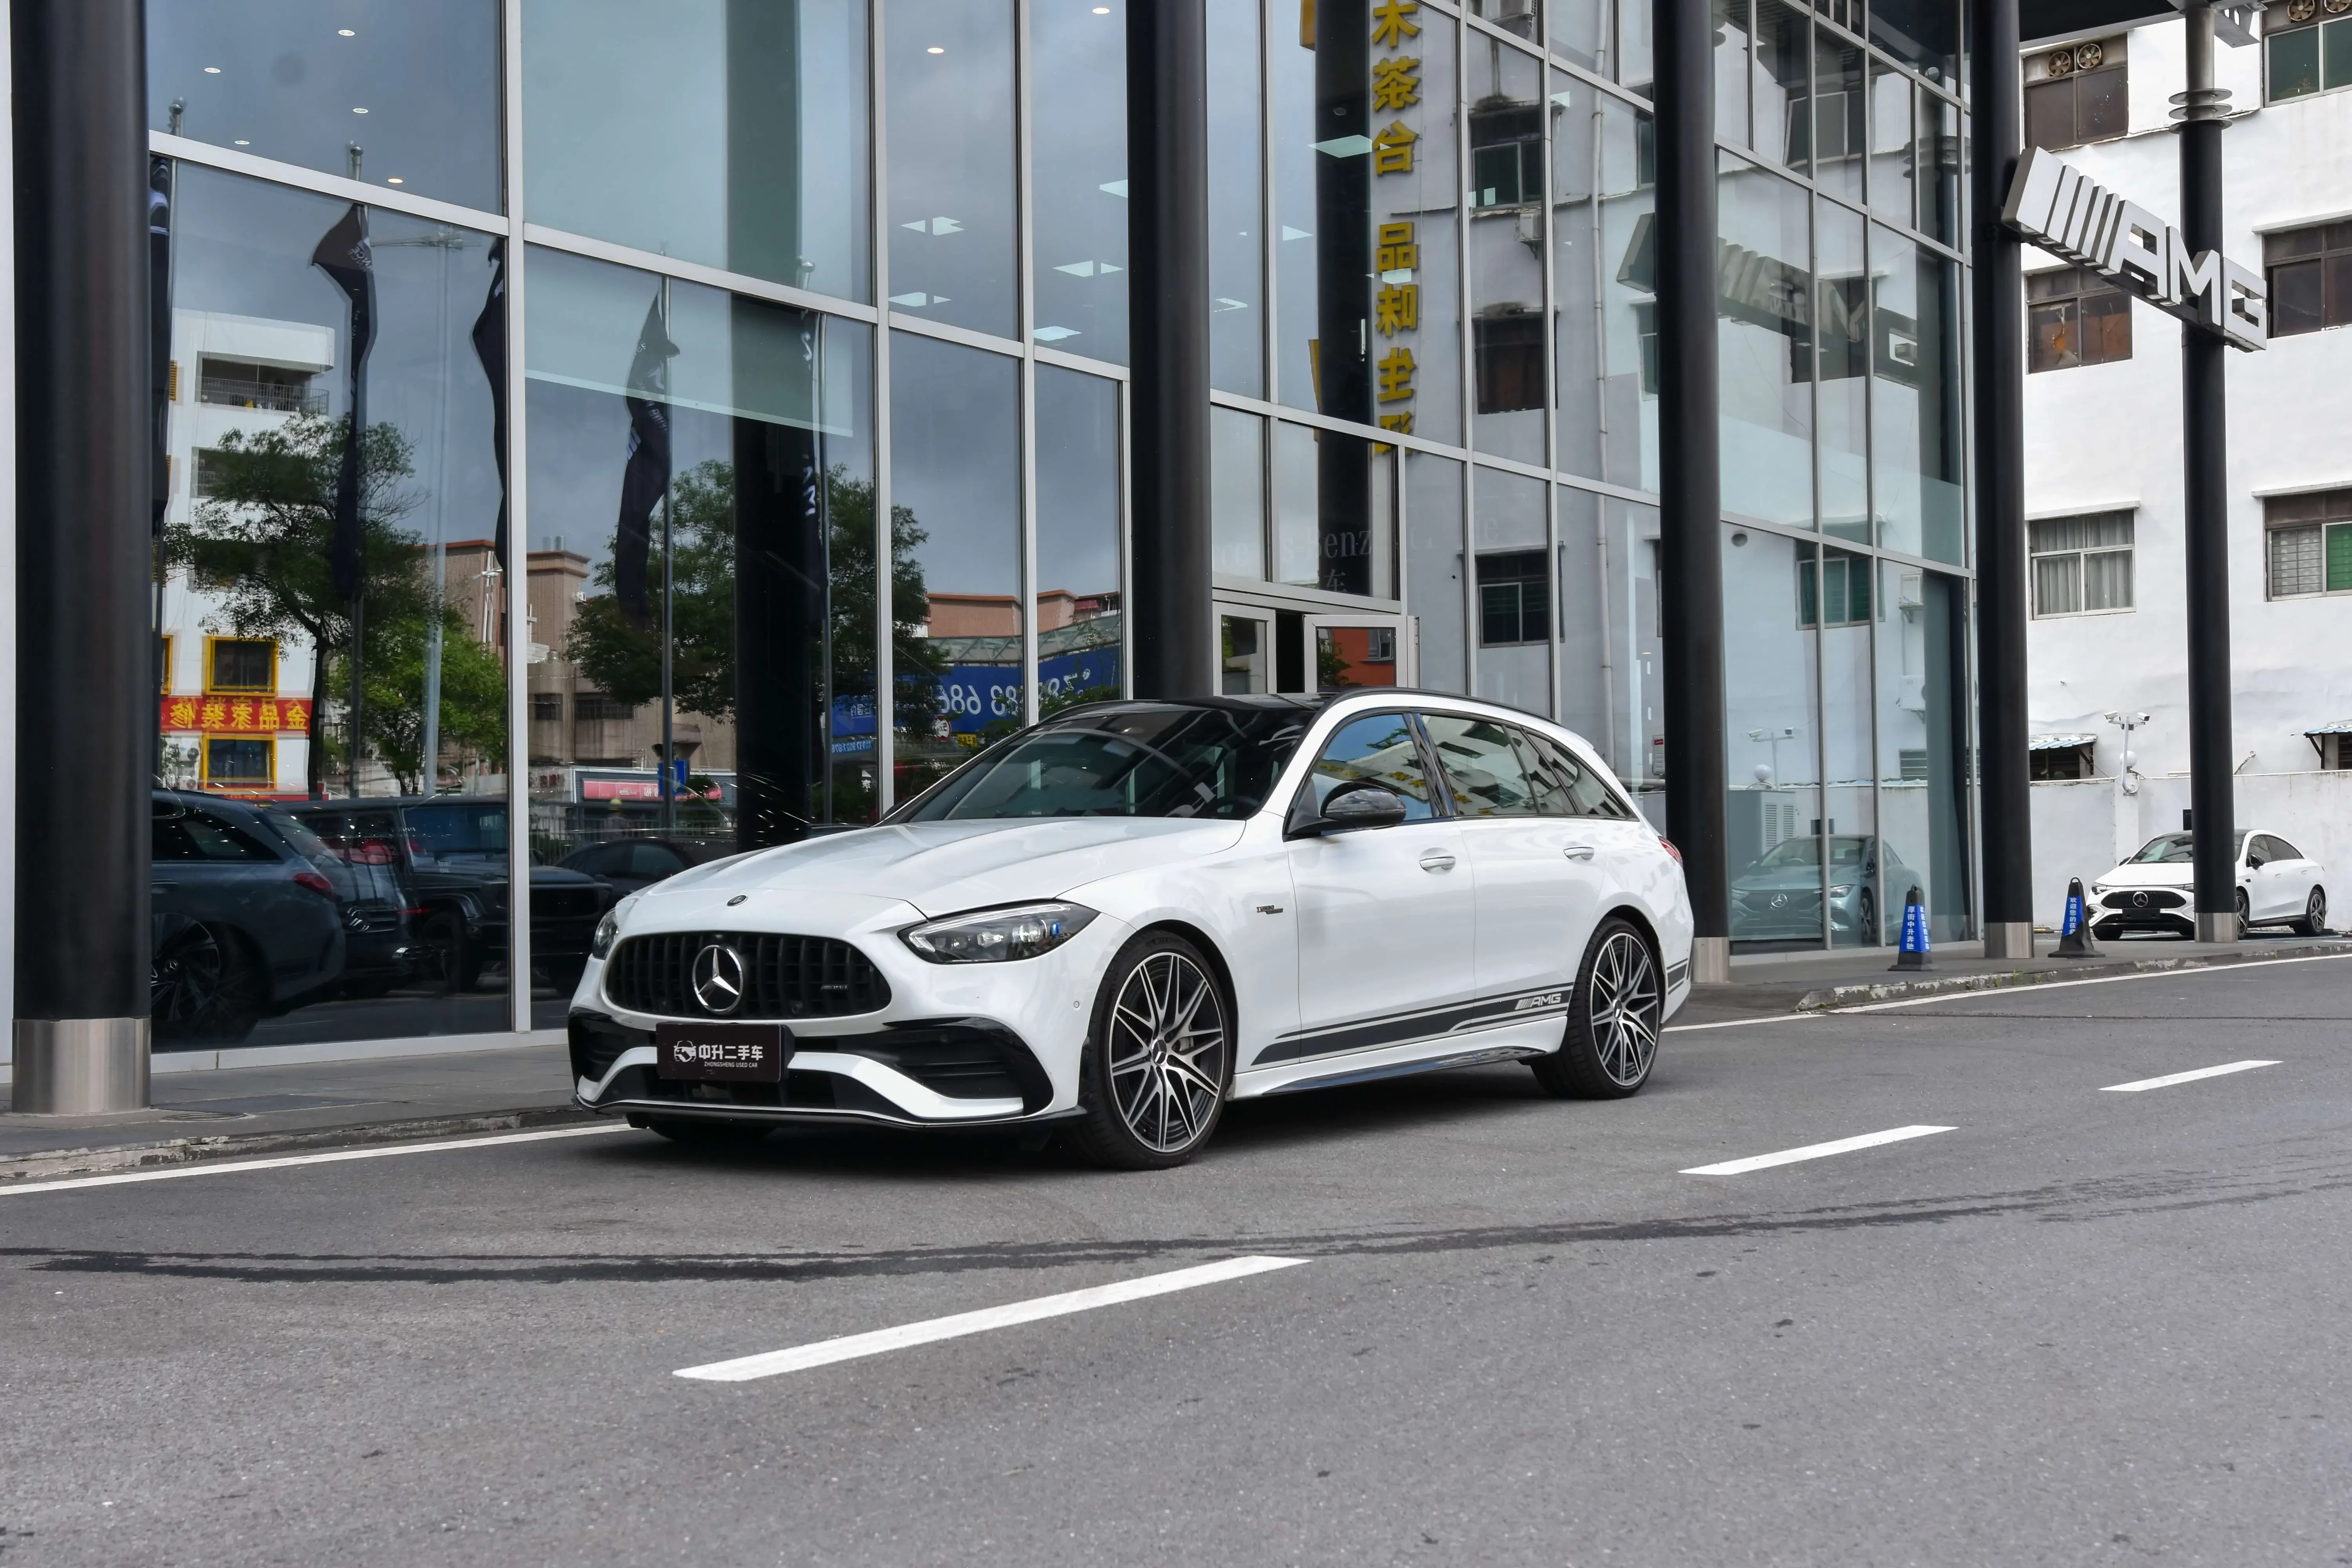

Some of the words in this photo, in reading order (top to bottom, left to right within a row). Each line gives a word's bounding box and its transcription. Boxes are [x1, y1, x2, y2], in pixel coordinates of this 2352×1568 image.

[1907, 906, 1915, 949] 厚街中升奔驰
[1530, 993, 1562, 1007] AMG
[698, 1044, 763, 1061] 中升二手车
